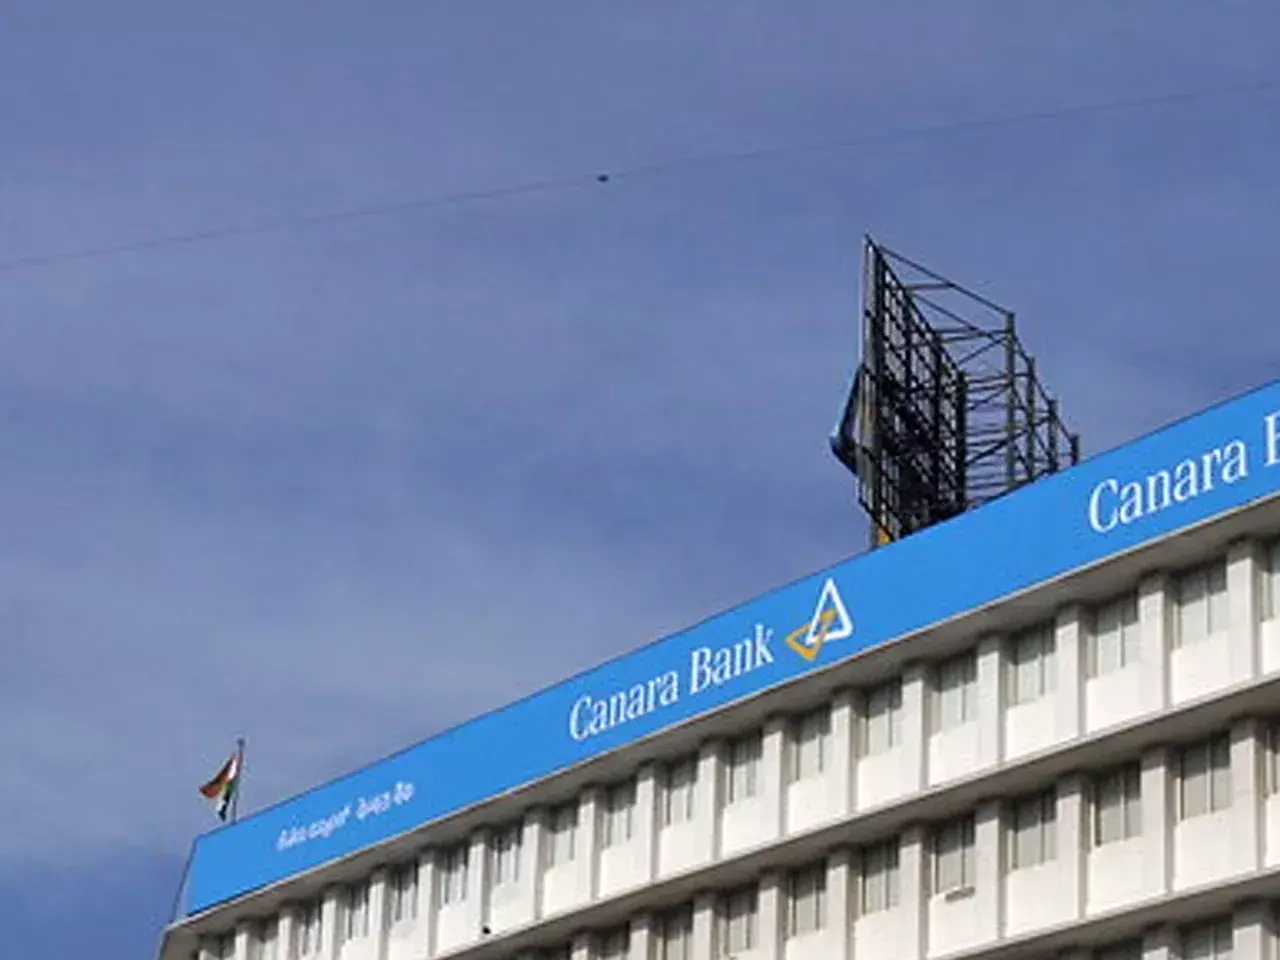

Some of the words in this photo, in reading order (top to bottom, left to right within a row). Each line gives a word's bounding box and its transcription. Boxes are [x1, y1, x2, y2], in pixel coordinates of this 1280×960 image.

[1088, 439, 1247, 533] Canara
[569, 670, 679, 742] Canara
[689, 623, 774, 695] Bank
